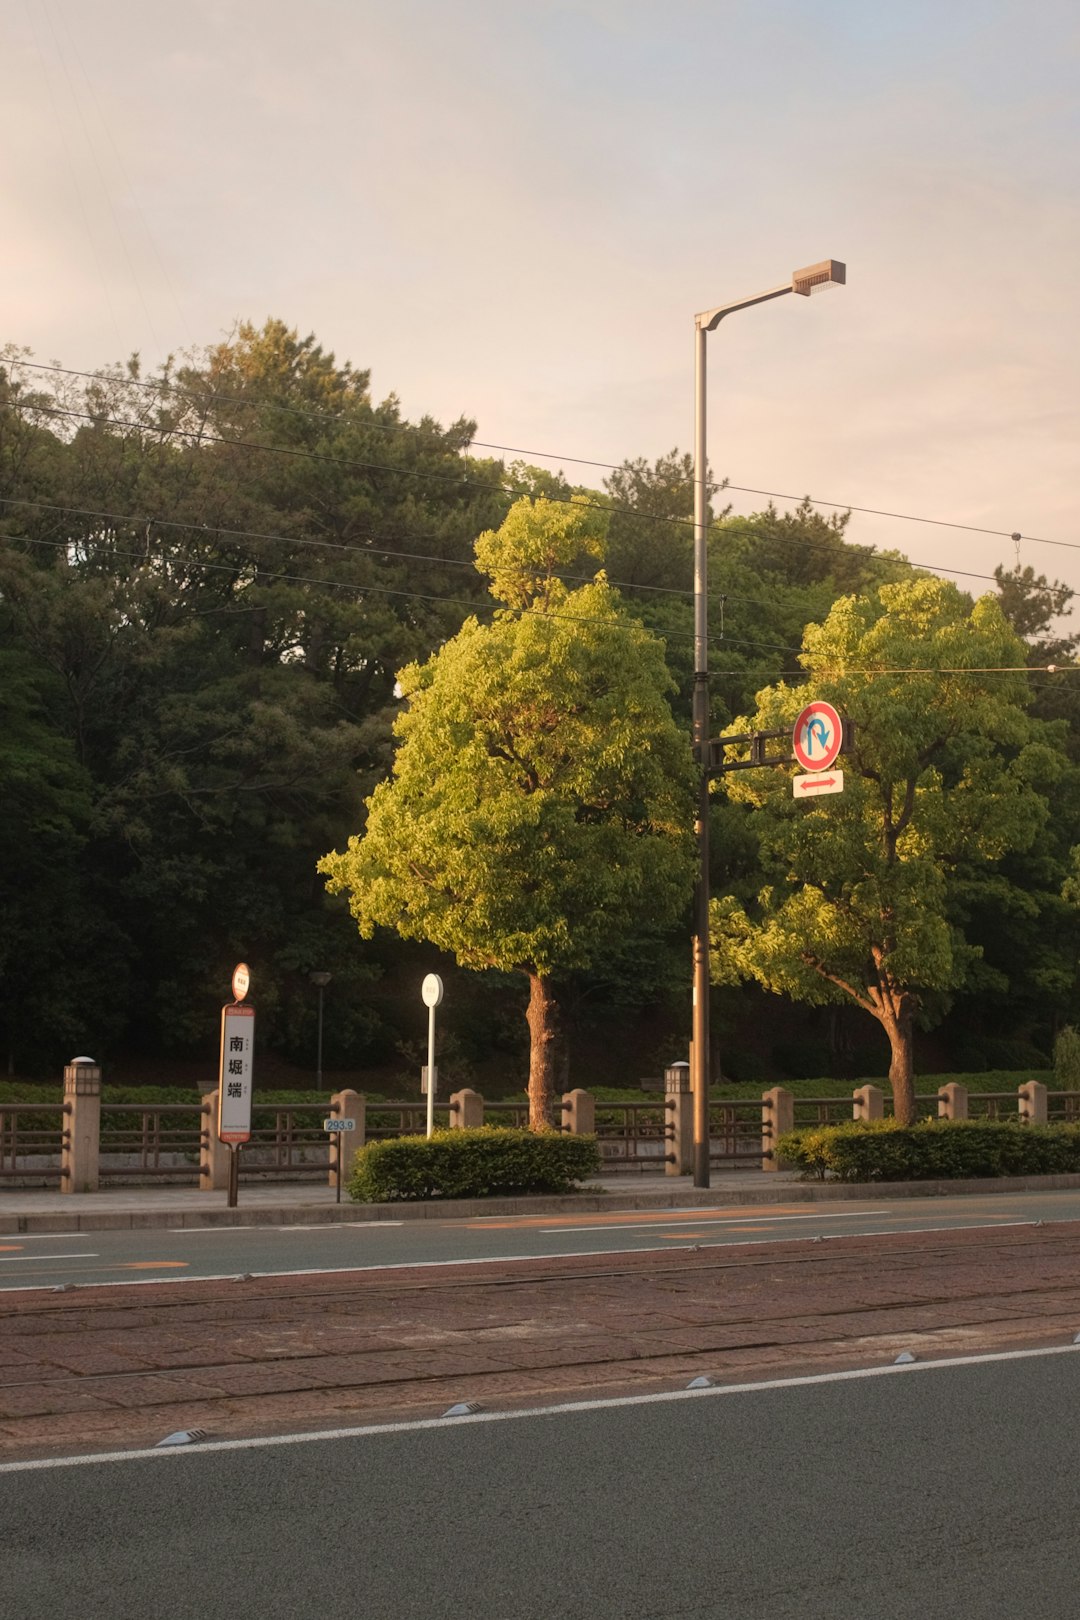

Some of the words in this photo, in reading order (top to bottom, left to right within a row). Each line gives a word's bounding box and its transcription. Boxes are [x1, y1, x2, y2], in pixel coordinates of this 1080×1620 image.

[227, 1036, 244, 1098] 南堀端
[327, 1120, 353, 1130] 293.9
